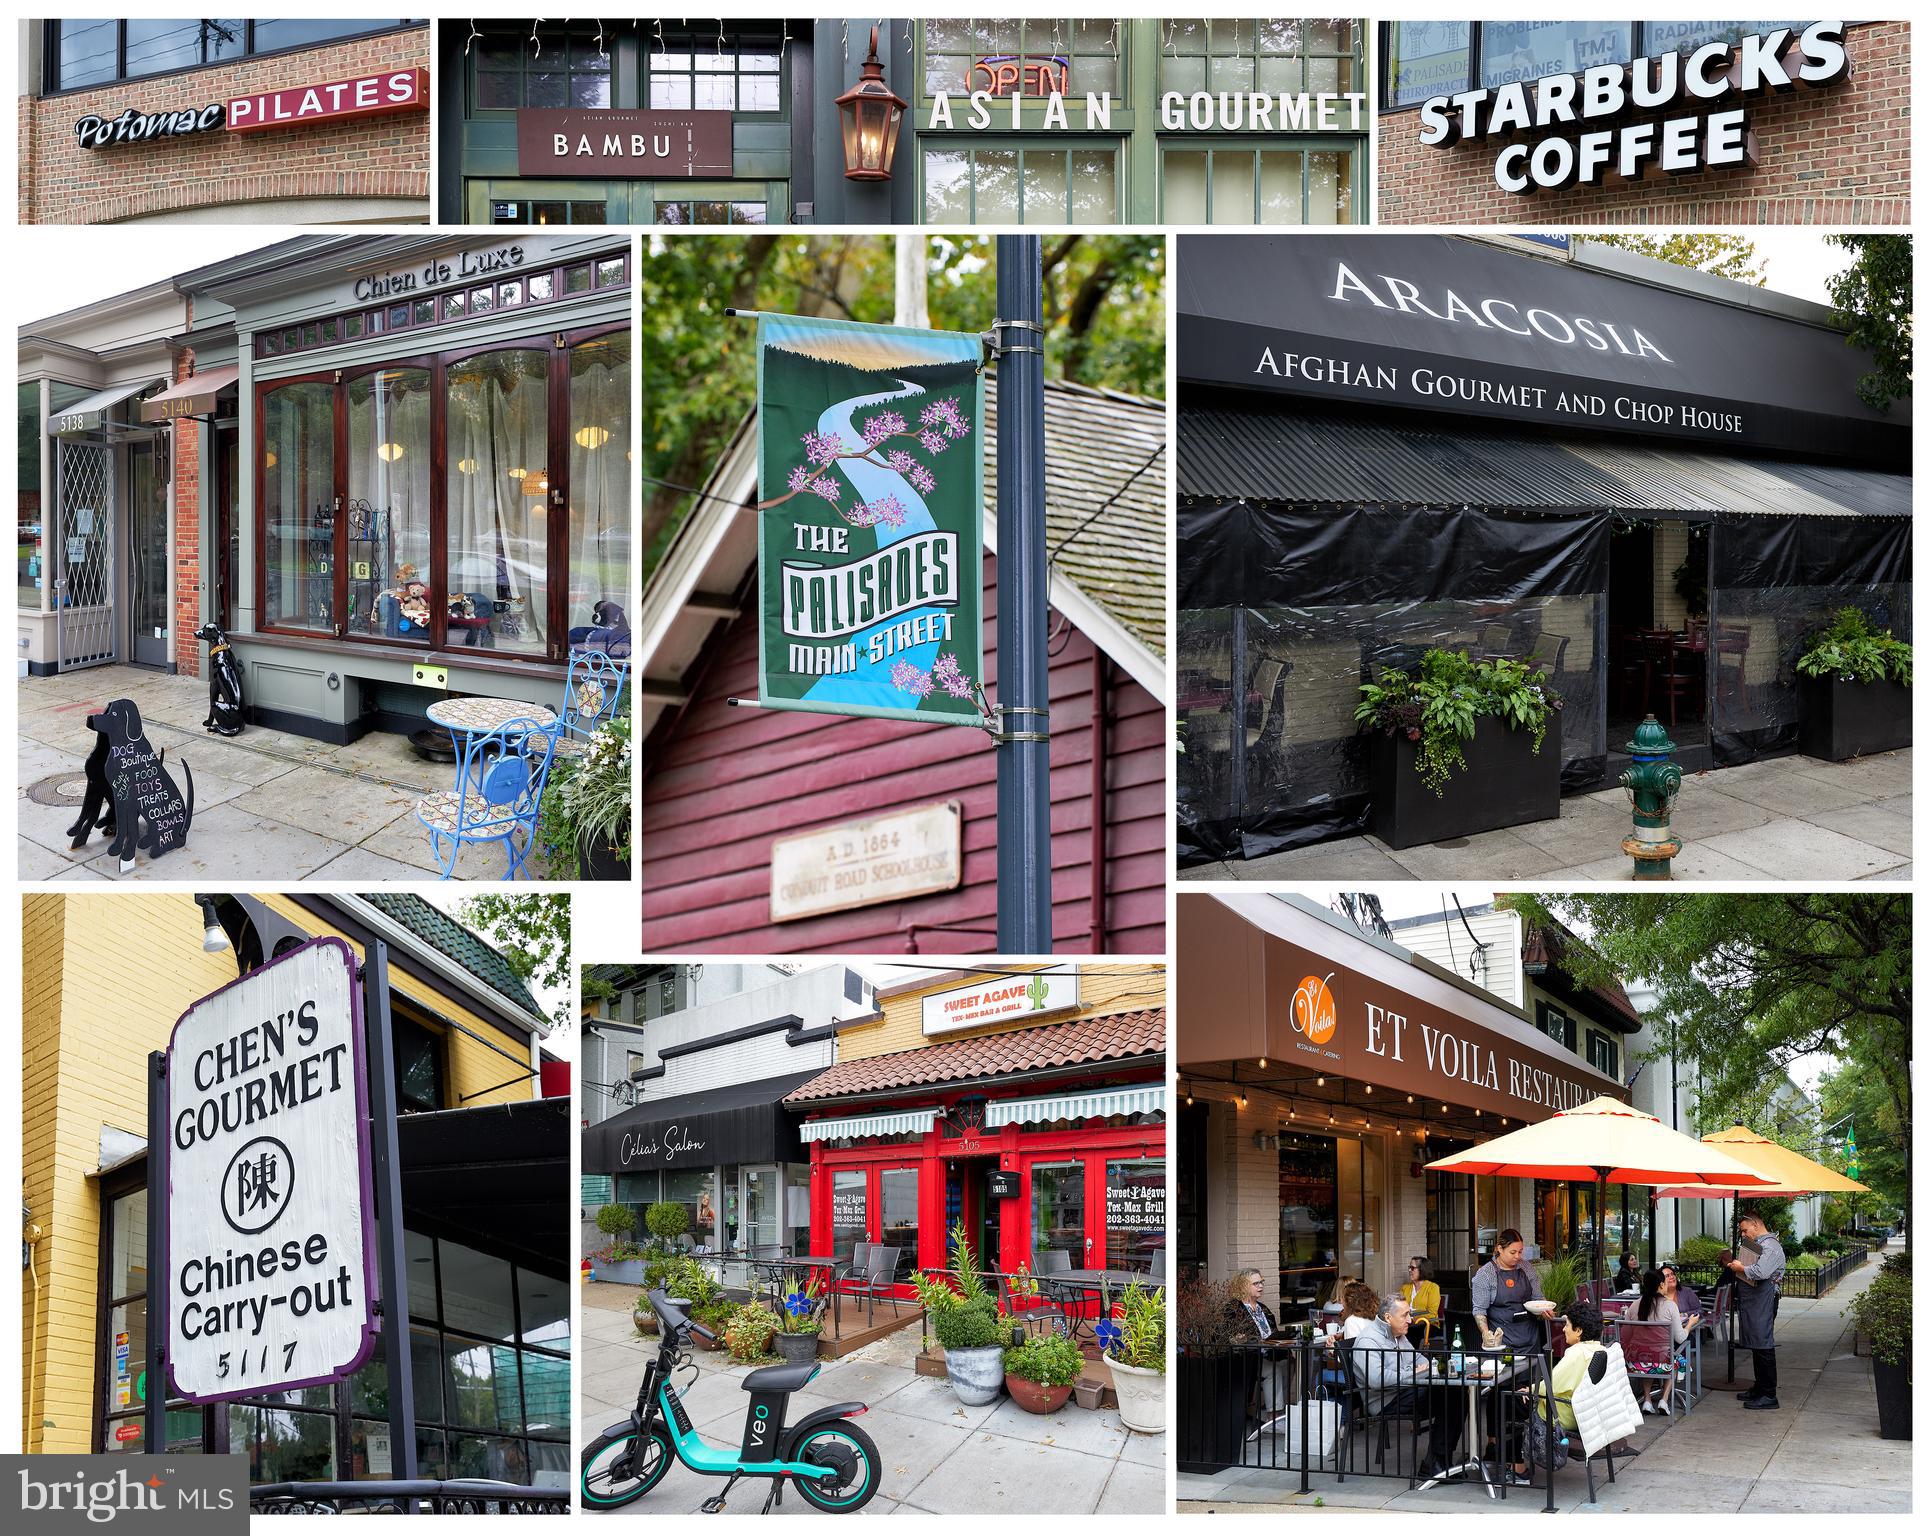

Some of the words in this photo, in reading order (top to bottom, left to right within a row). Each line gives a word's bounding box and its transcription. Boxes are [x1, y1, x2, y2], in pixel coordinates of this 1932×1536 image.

[1579, 35, 1617, 58] TMJ
[965, 62, 1069, 96] OPEN
[1419, 20, 1847, 146] STARBUCKS
[1486, 59, 1563, 87] MIGRAINES
[76, 103, 221, 147] Potomac
[230, 72, 414, 127] PILATES
[928, 91, 1112, 130] ASIAN
[1161, 92, 1366, 131] GOURMET
[553, 133, 671, 158] BAMBU
[1495, 109, 1746, 194] COFFEE
[353, 271, 417, 301] Chien
[421, 258, 451, 285] de
[456, 244, 525, 277] Luxe
[1328, 260, 1676, 364] ARACOSIA
[1253, 346, 1399, 392] AFGHAN
[1411, 368, 1547, 409] GOURMET
[1555, 391, 1607, 417] AND
[1614, 397, 1674, 426] CHOP
[1681, 405, 1743, 434] HOUSE
[160, 399, 193, 418] 5140
[60, 414, 84, 432] 5138
[794, 523, 850, 554] THE
[358, 563, 367, 576] G
[789, 535, 949, 633] PALISADES
[789, 643, 857, 675] MAIN
[869, 613, 956, 662] STREET
[112, 743, 134, 758] DOG
[120, 751, 157, 769] Boutique
[135, 766, 158, 781] FOOD
[135, 778, 163, 794] TOYS
[137, 790, 169, 809] TREATS
[148, 799, 183, 820] COLLARS
[156, 813, 184, 831] BOWLS
[159, 830, 174, 847] ART
[944, 995, 980, 1013] SWEET
[983, 985, 1026, 1005] AGAVE
[980, 1008, 994, 1017] BAR
[1002, 1003, 1021, 1012] GRILL
[194, 999, 319, 1092] CHEN'S
[1365, 1001, 1407, 1063] ET
[1420, 1023, 1500, 1091] VOILA
[174, 1043, 347, 1151] GOURMET
[664, 1125, 706, 1161] Salon
[959, 1140, 980, 1151] 5105
[237, 1153, 281, 1217] 陳
[1106, 1186, 1130, 1198] Sweet
[1140, 1186, 1165, 1200] Agave
[1106, 1201, 1142, 1213] Tex-Mex
[1145, 1201, 1164, 1213] Grill
[1106, 1215, 1165, 1224] 202-363-4041
[180, 1233, 328, 1297] Chinese
[180, 1266, 353, 1341] Carry-out
[117, 1346, 129, 1355] VISA
[750, 1404, 769, 1447] veo
